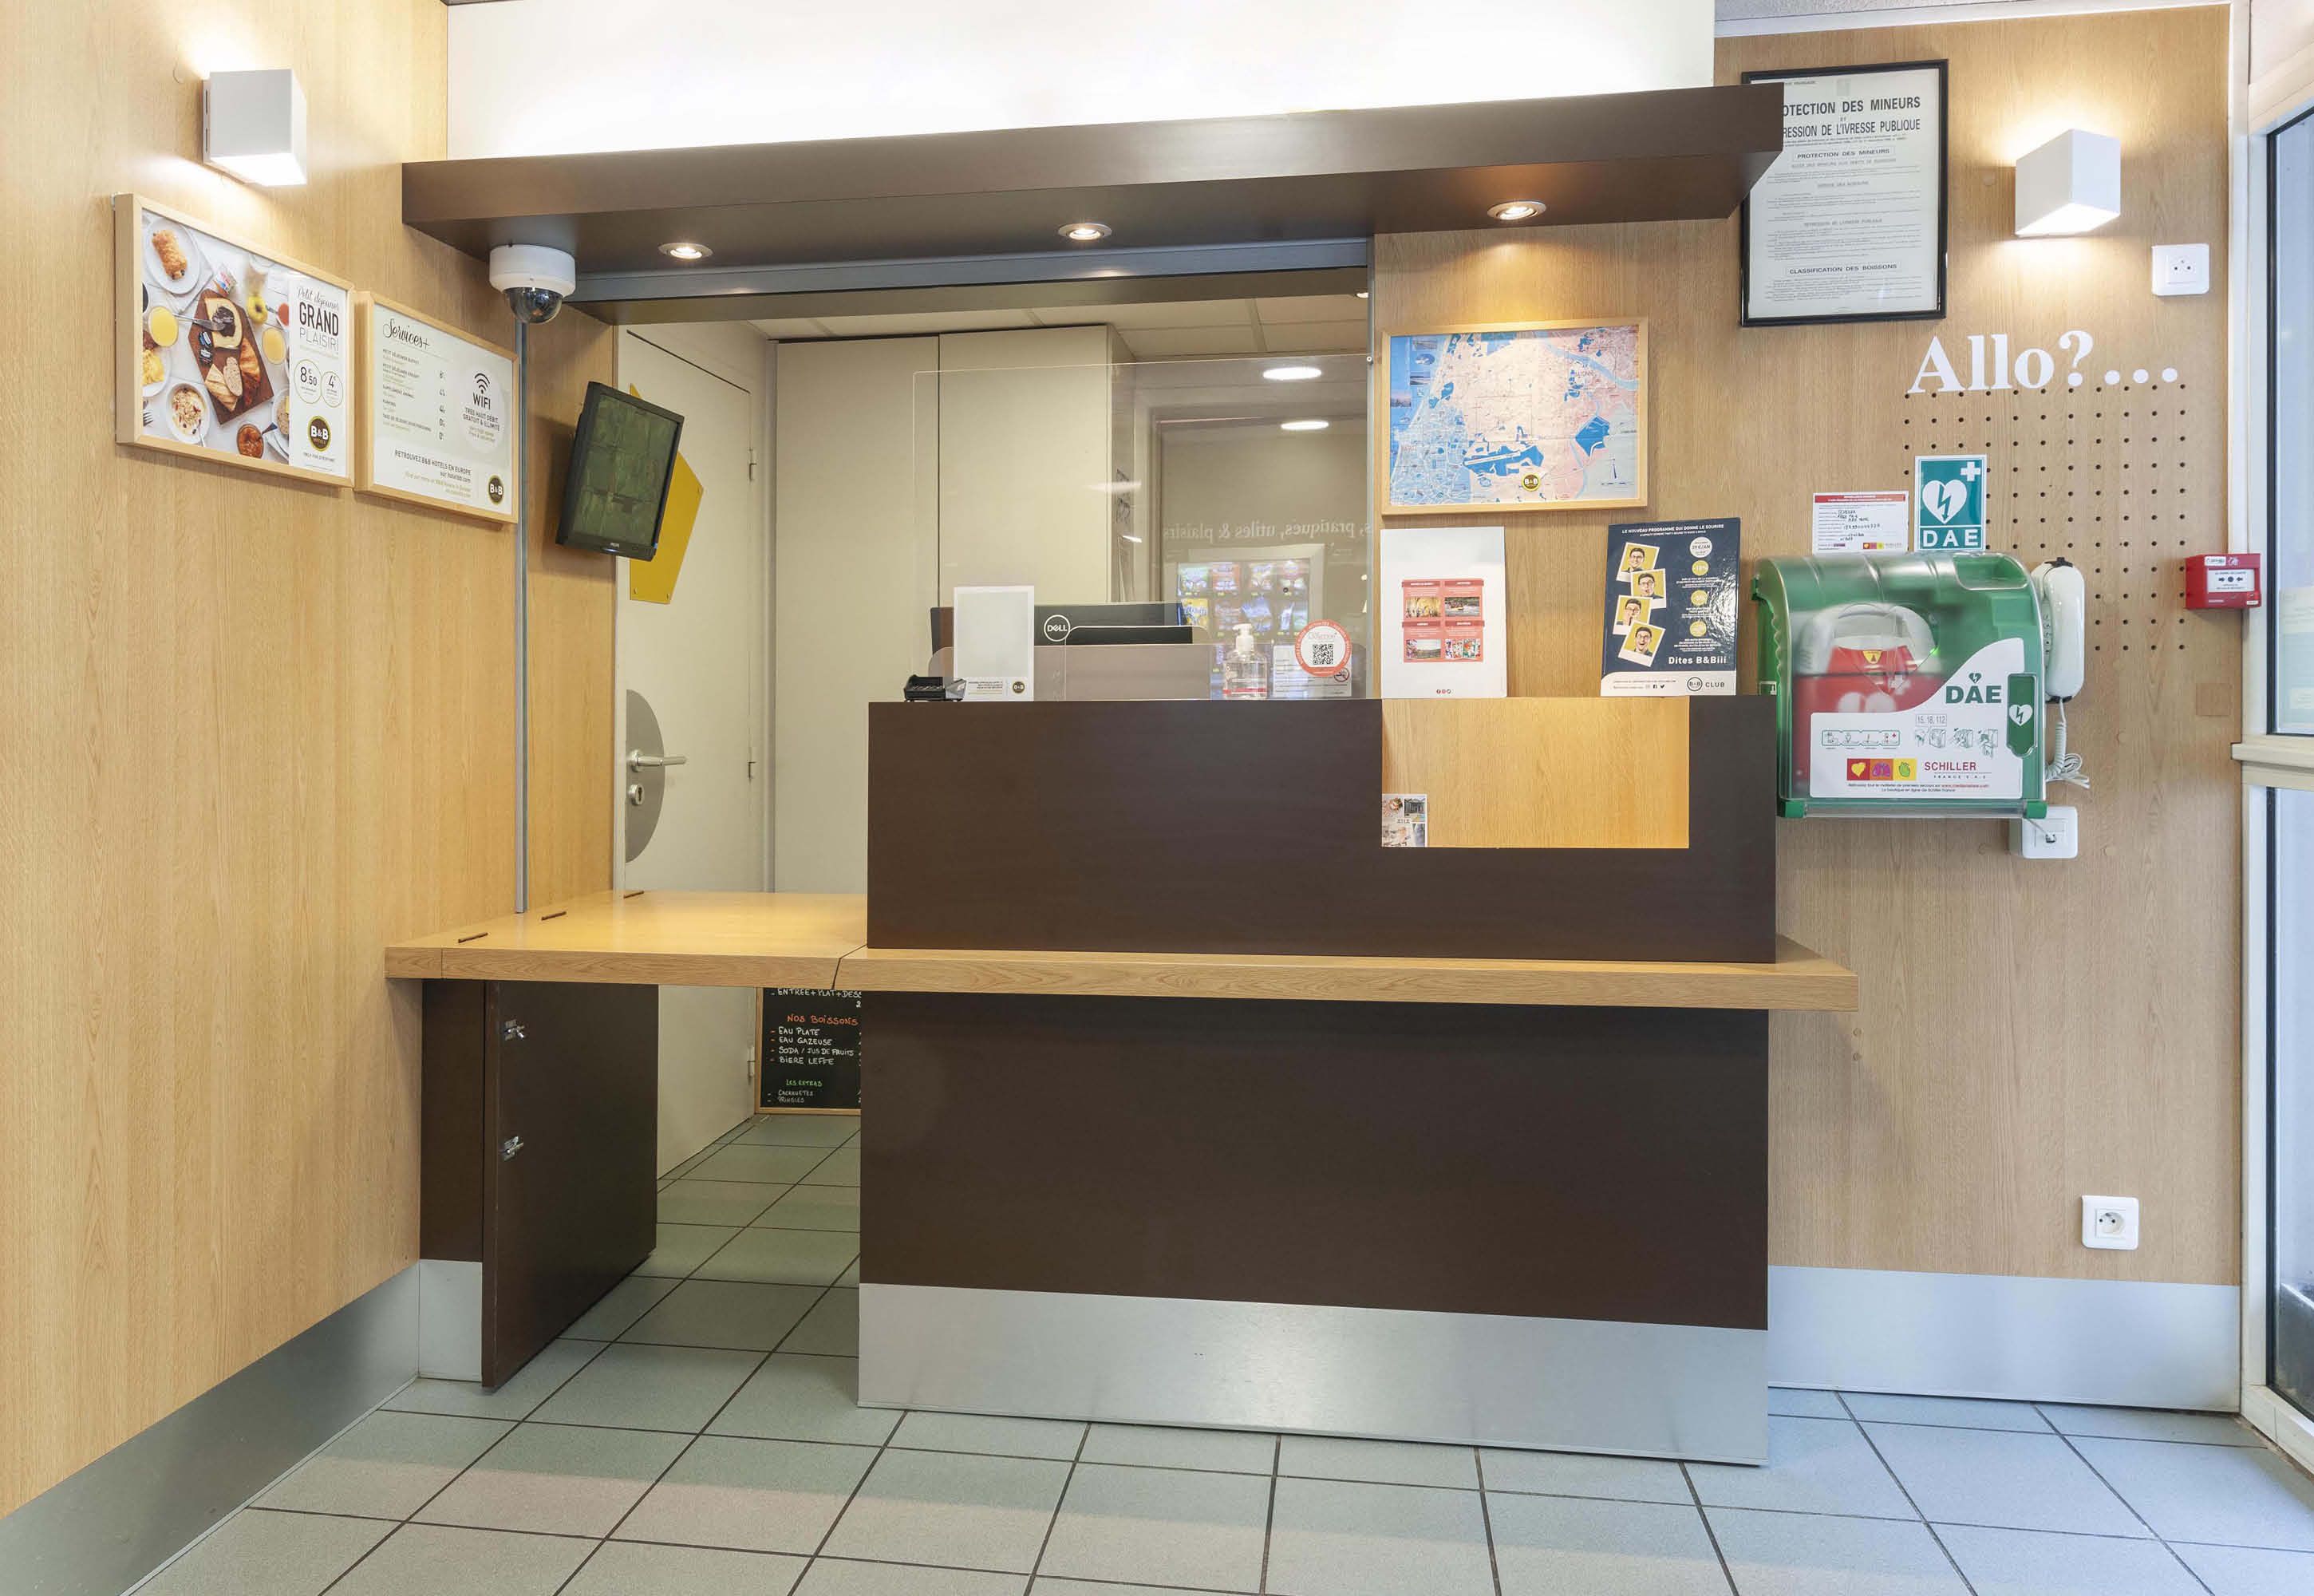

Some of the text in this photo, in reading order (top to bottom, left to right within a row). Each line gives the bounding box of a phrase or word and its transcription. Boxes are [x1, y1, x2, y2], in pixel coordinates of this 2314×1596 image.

[1783, 97, 1921, 117] OTECTION DES MINEURS
[1783, 118, 1921, 138] RESSION DE L'IVRESSE PUBLIQUE
[299, 302, 339, 337] GRAND
[472, 392, 491, 410] WIFI
[310, 425, 329, 440] B&B
[395, 449, 421, 463] RETROUVEZ
[432, 460, 447, 470] HOTELS
[455, 466, 471, 476] EUROPE
[489, 483, 503, 496] B&B
[1923, 529, 1979, 547] DAE
[1945, 685, 2002, 703] DAE
[1924, 761, 1976, 771] SCHILLER
[787, 1013, 806, 1022] NOS
[778, 1026, 820, 1036] EAU PLATE
